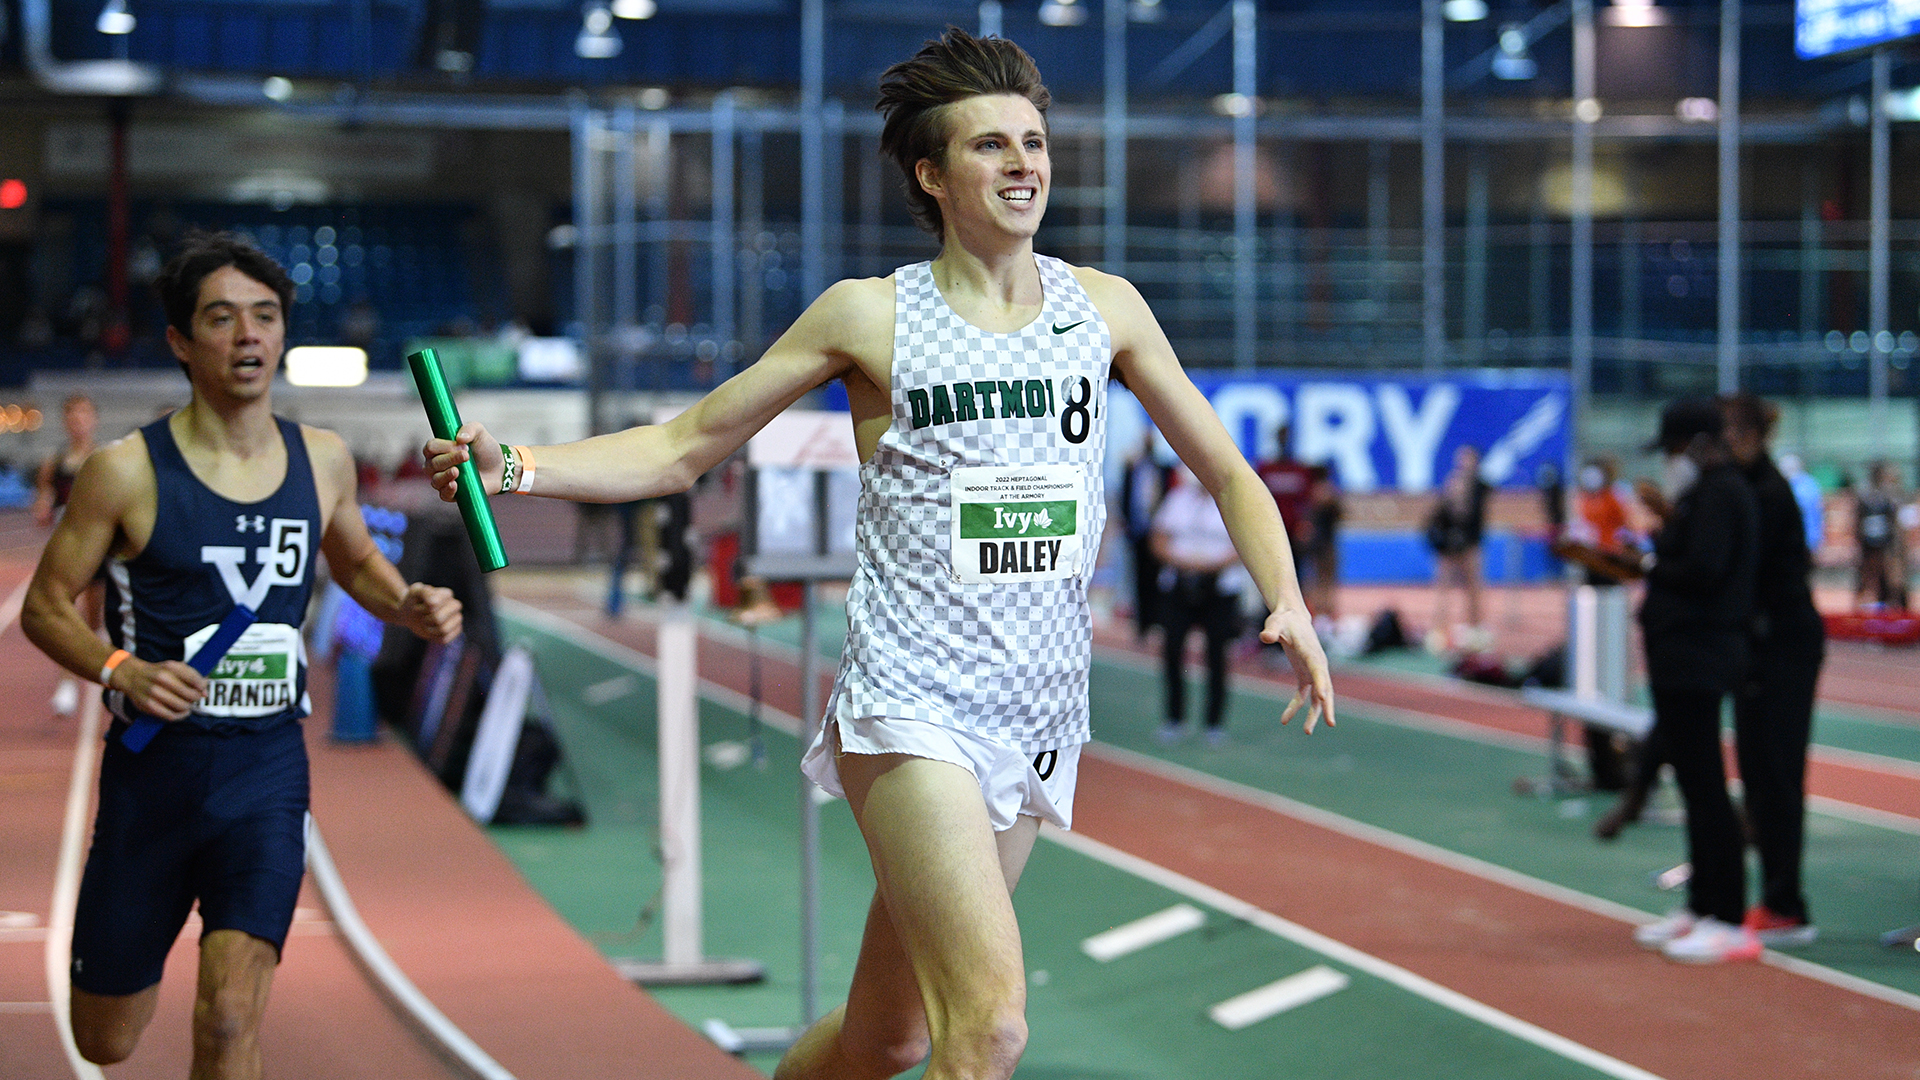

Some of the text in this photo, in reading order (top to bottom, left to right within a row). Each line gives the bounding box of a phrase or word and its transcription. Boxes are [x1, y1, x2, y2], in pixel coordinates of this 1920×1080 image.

[907, 378, 1099, 430] DARTMO
[1060, 374, 1092, 444] 8
[1107, 380, 1461, 491] ORY
[502, 453, 515, 491] DXC
[993, 507, 1033, 534] Ivy
[275, 526, 303, 579] 5
[979, 540, 1062, 574] DALEY
[214, 656, 250, 679] Ivy
[197, 682, 291, 707] IRANDA
